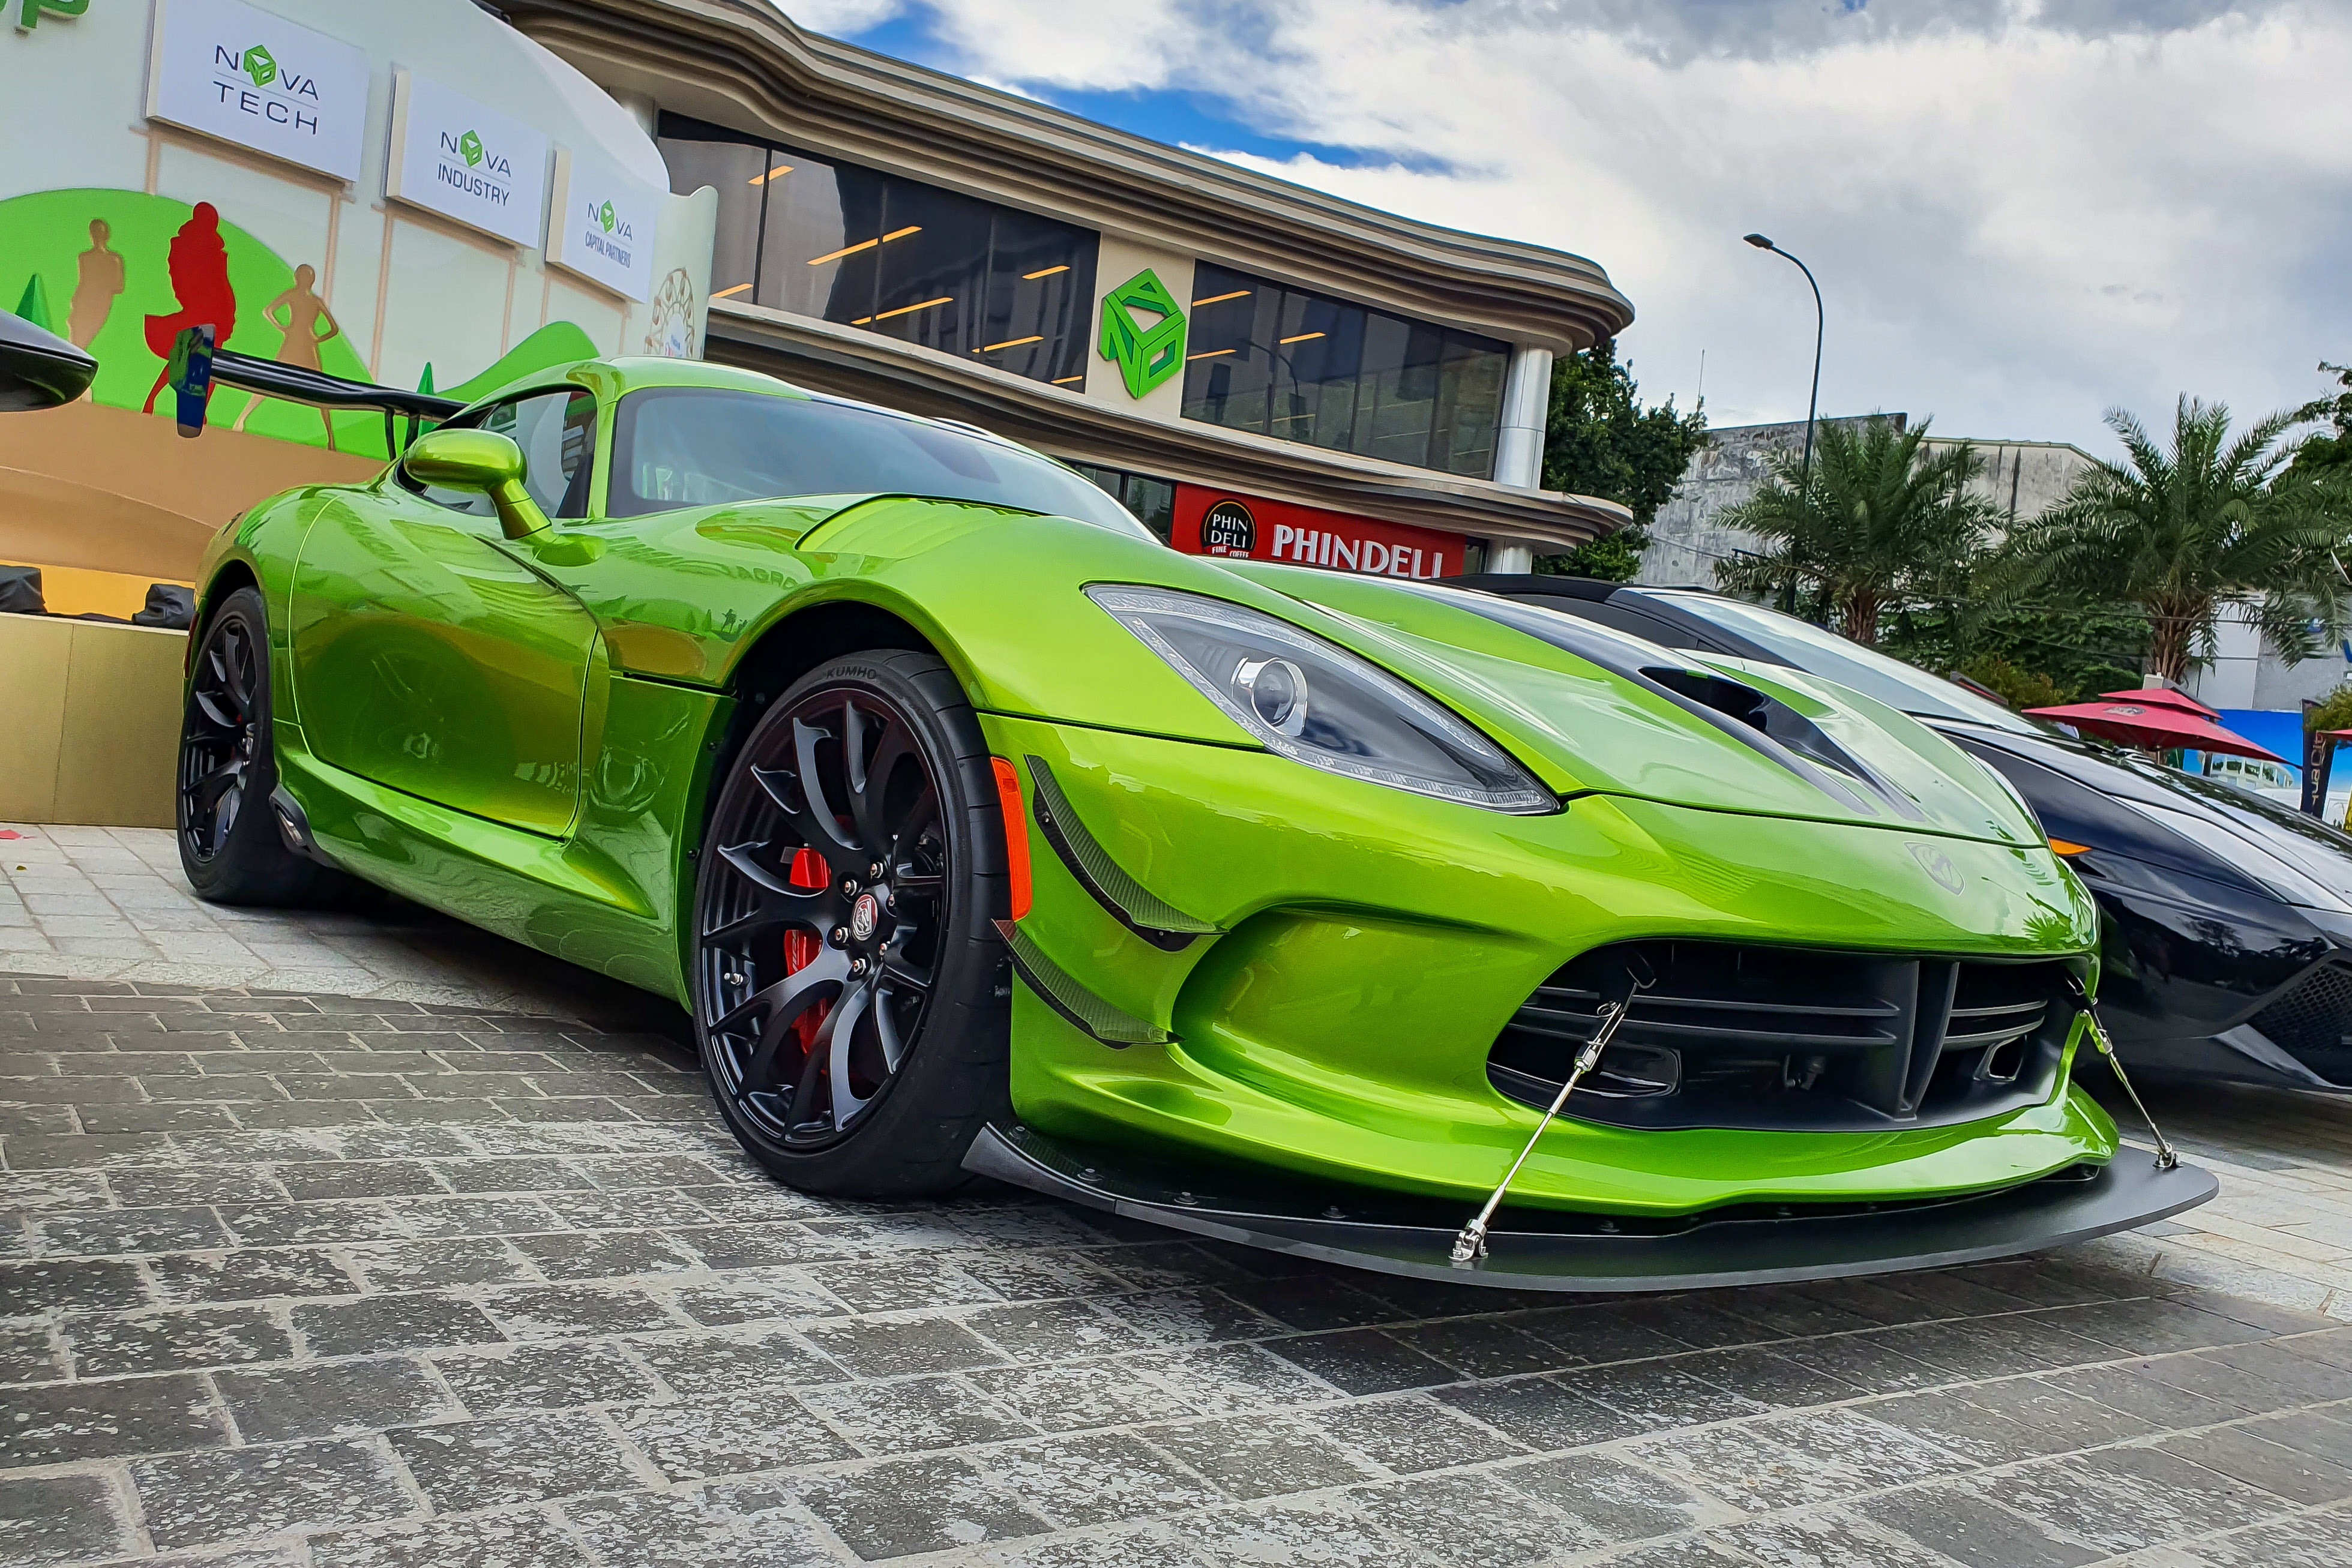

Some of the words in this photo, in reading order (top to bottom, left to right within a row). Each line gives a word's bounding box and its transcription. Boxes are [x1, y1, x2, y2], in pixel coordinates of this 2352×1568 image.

[213, 80, 317, 135] TECH
[438, 163, 510, 206] INDUSTRY
[585, 230, 604, 255] CAPITAL
[606, 242, 631, 268] PARTNERS
[1212, 513, 1248, 532] PHIN
[1211, 530, 1246, 548] DELI
[1212, 545, 1227, 554] FINE
[1271, 524, 1443, 579] PHINDELI
[826, 665, 877, 679] KUMHO
